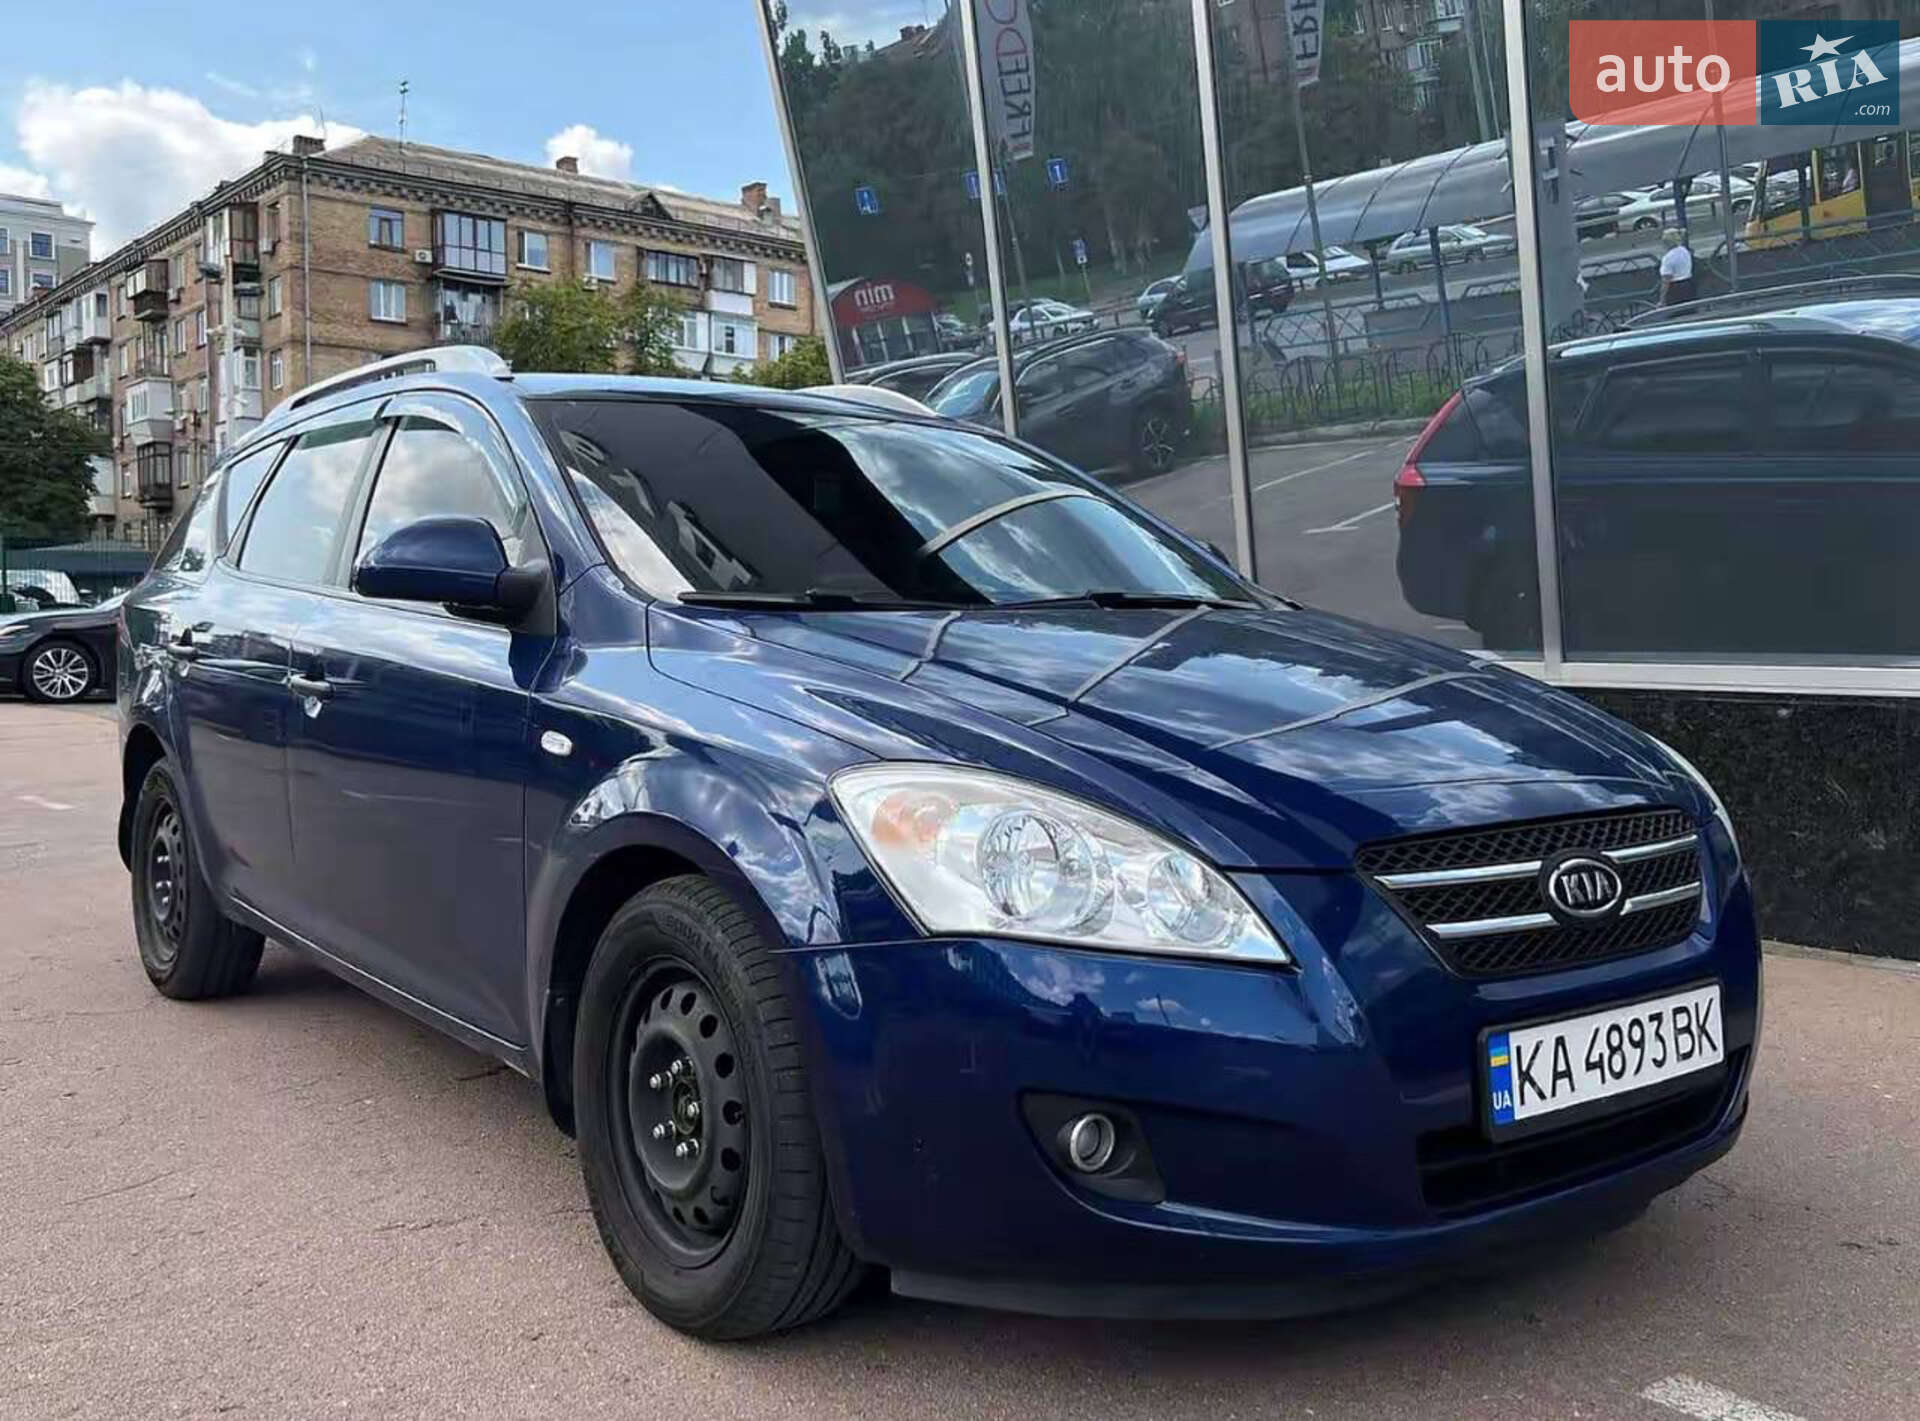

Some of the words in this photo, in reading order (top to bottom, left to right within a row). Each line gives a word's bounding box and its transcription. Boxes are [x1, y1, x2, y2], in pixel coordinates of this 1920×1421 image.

[1560, 871, 1613, 905] KIA
[1515, 1035, 1576, 1106] KA
[1584, 1012, 1667, 1085] 4893
[1672, 997, 1718, 1063] BK
[1492, 1090, 1513, 1110] UA
